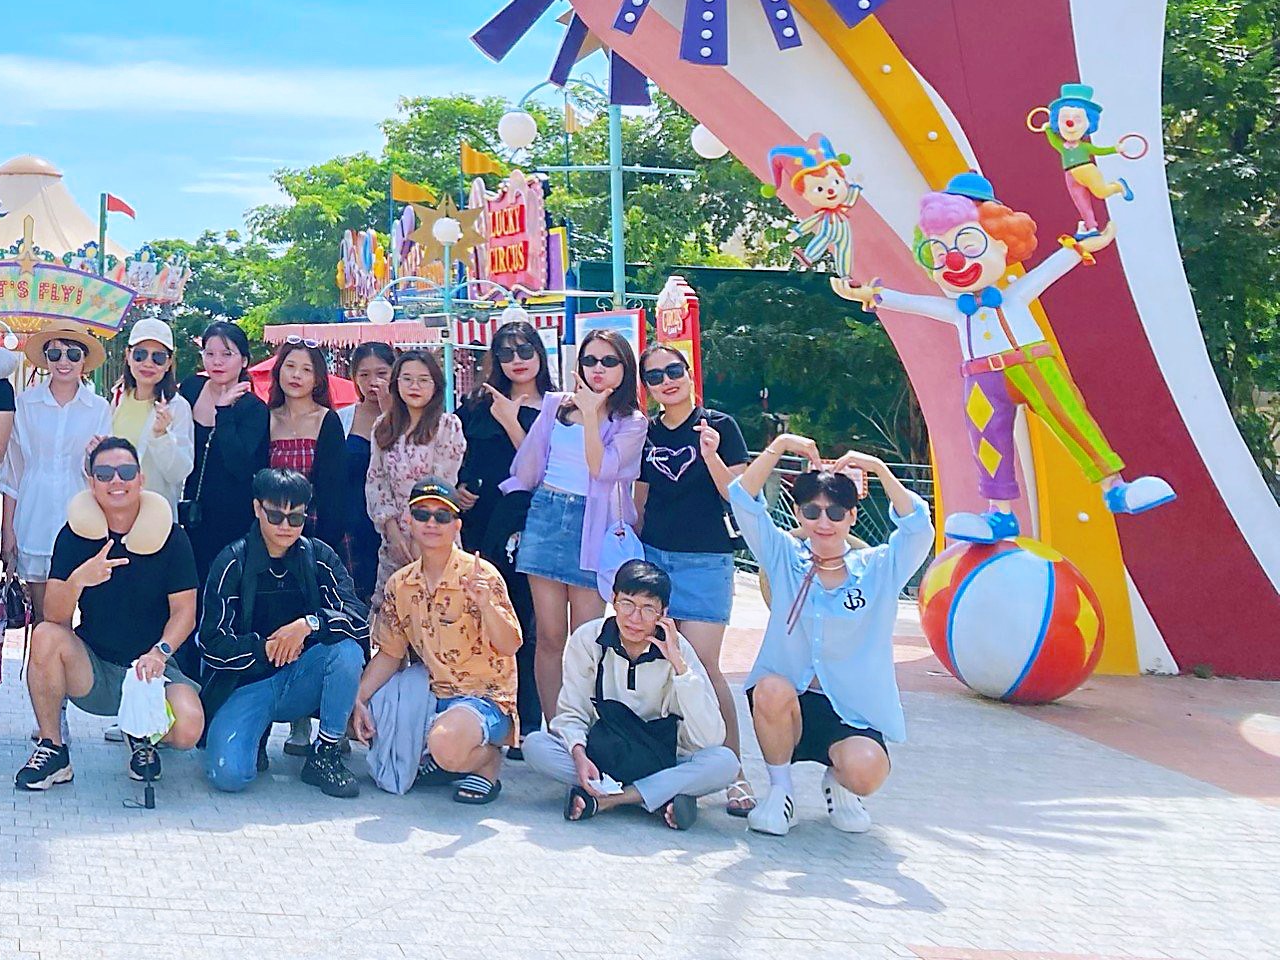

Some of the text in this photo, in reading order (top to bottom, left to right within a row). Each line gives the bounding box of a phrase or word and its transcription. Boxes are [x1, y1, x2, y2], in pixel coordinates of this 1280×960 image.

[489, 205, 521, 237] LUCKY
[489, 241, 525, 274] CIRCUS
[38, 281, 84, 306] FLY!
